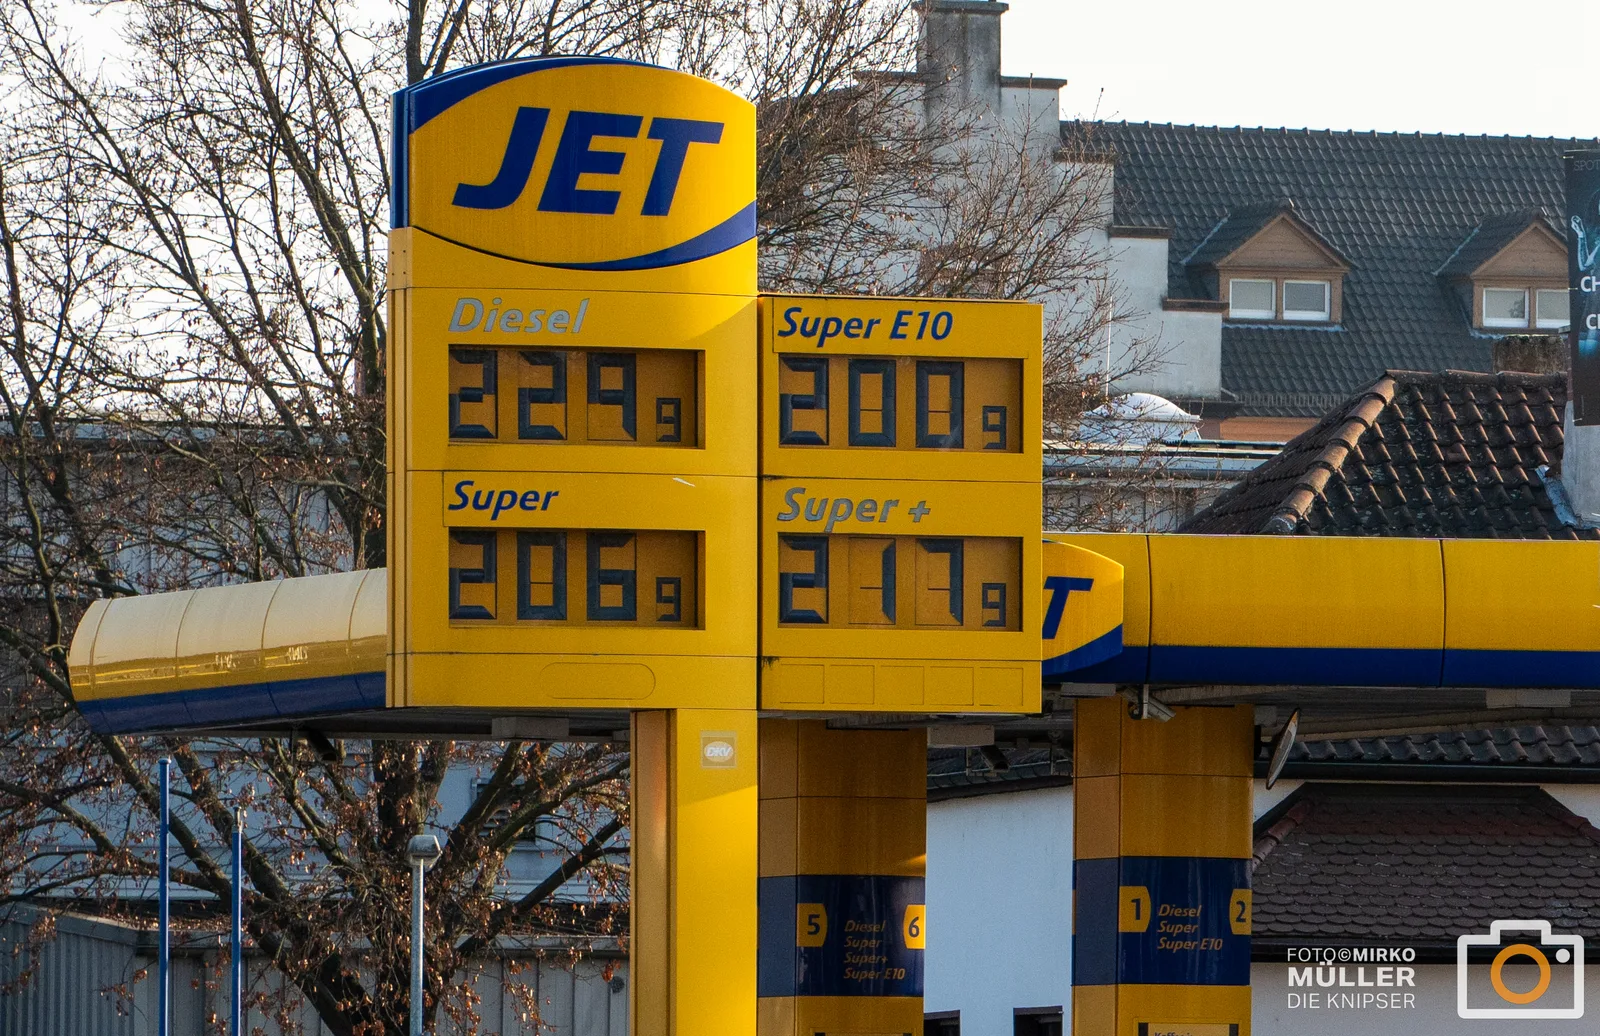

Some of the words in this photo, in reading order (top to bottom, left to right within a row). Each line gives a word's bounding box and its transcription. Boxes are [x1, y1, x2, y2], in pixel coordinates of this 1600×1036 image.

[451, 106, 725, 217] JET
[448, 297, 590, 334] Diesel
[778, 307, 880, 348] Super
[889, 310, 953, 340] E10
[448, 480, 560, 520] Super
[777, 487, 898, 532] Super
[1131, 898, 1141, 920] 1
[1158, 904, 1202, 917] Diesel
[1235, 901, 1246, 922] 2
[807, 914, 820, 935] 5
[844, 920, 886, 932] Diesel
[908, 916, 920, 938] 6
[1157, 921, 1198, 936] Super
[844, 936, 882, 951] Super
[1157, 937, 1198, 953] Super
[1200, 938, 1223, 950] E10
[843, 968, 881, 982] Super
[884, 968, 906, 980] E10
